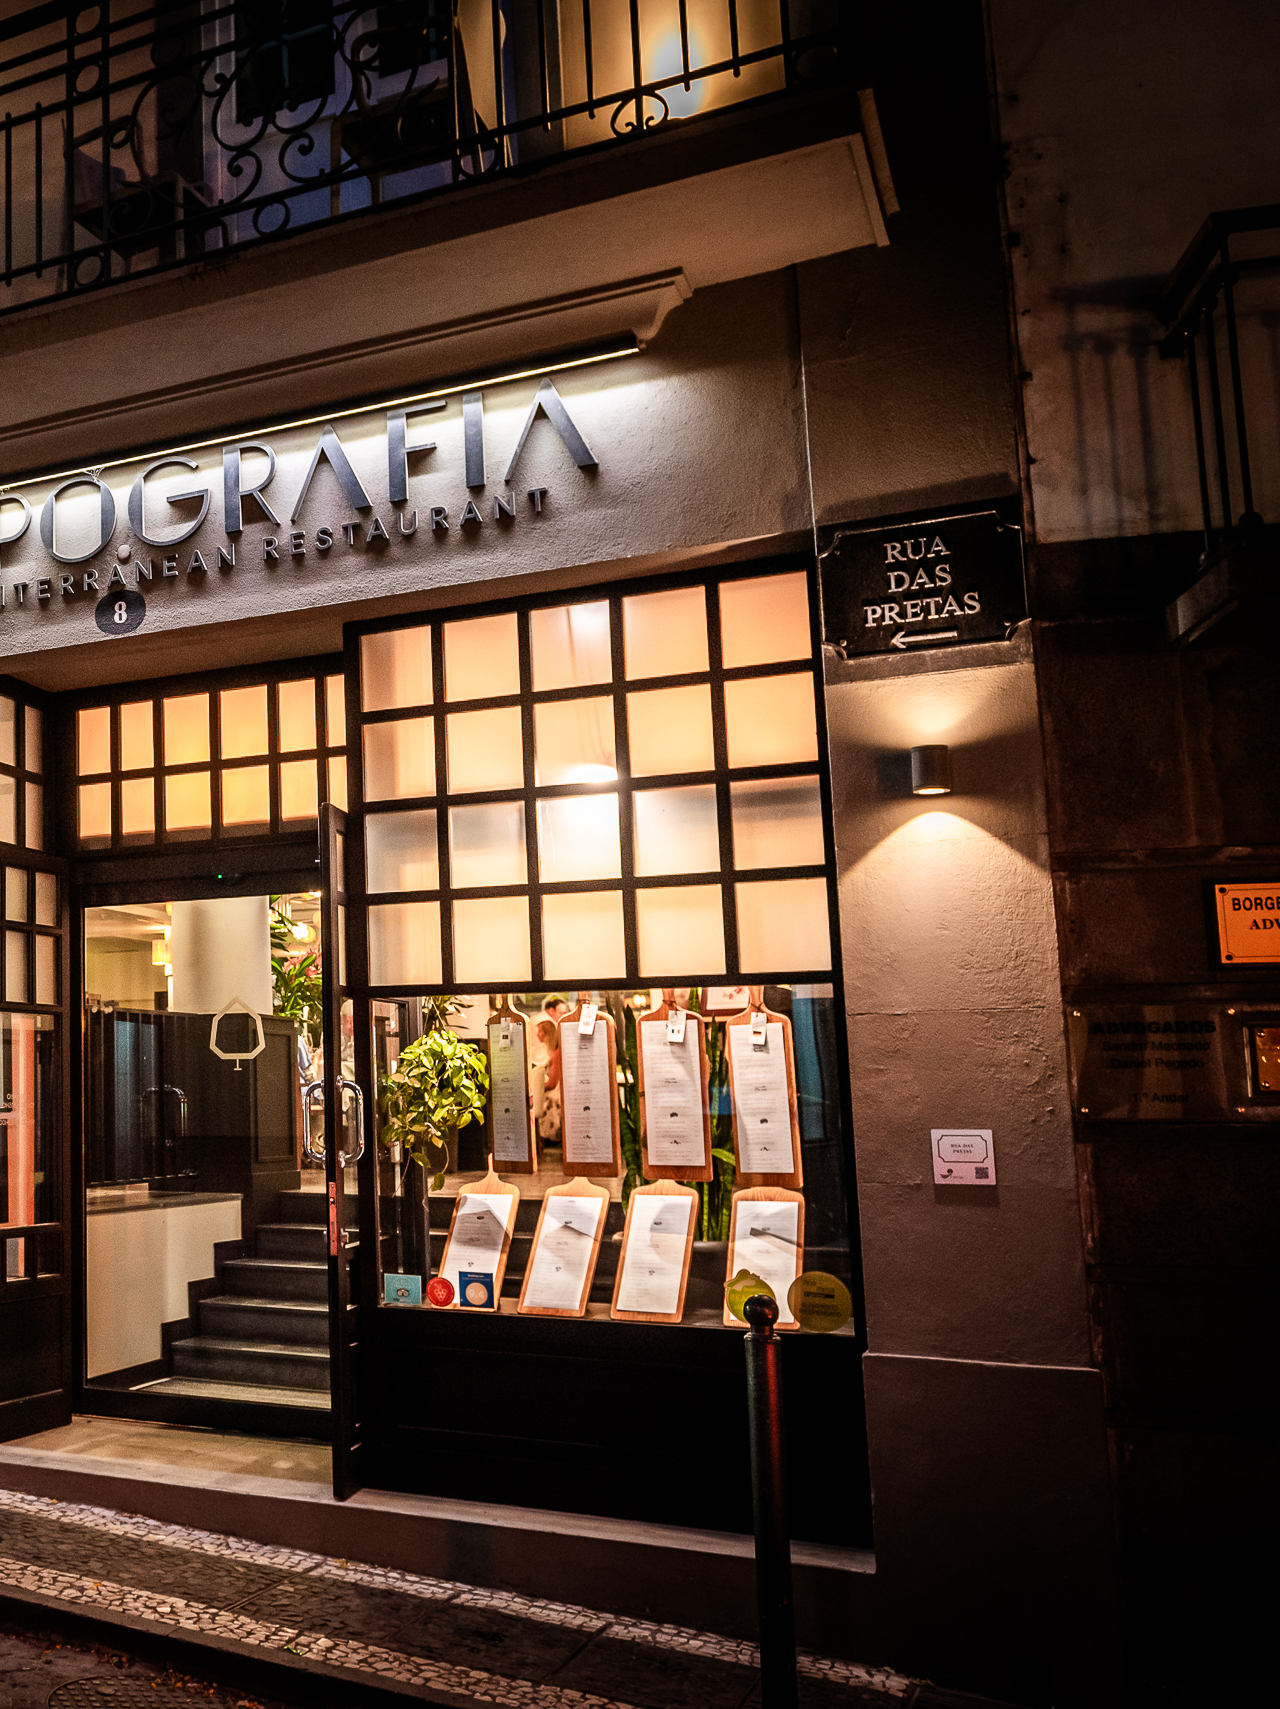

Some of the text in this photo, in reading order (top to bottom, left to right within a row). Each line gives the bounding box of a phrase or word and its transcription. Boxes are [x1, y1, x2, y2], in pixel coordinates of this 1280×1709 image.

[261, 486, 548, 561] RESTAURANT
[883, 535, 951, 563] RUA
[887, 563, 952, 593] DAS
[113, 600, 128, 624] 8
[863, 591, 981, 627] PRETAS
[1092, 1021, 1217, 1035] ADVOGADOS
[1152, 1041, 1211, 1051] Machado
[1111, 1058, 1151, 1070] Daniel
[1152, 1093, 1190, 1103] Andar
